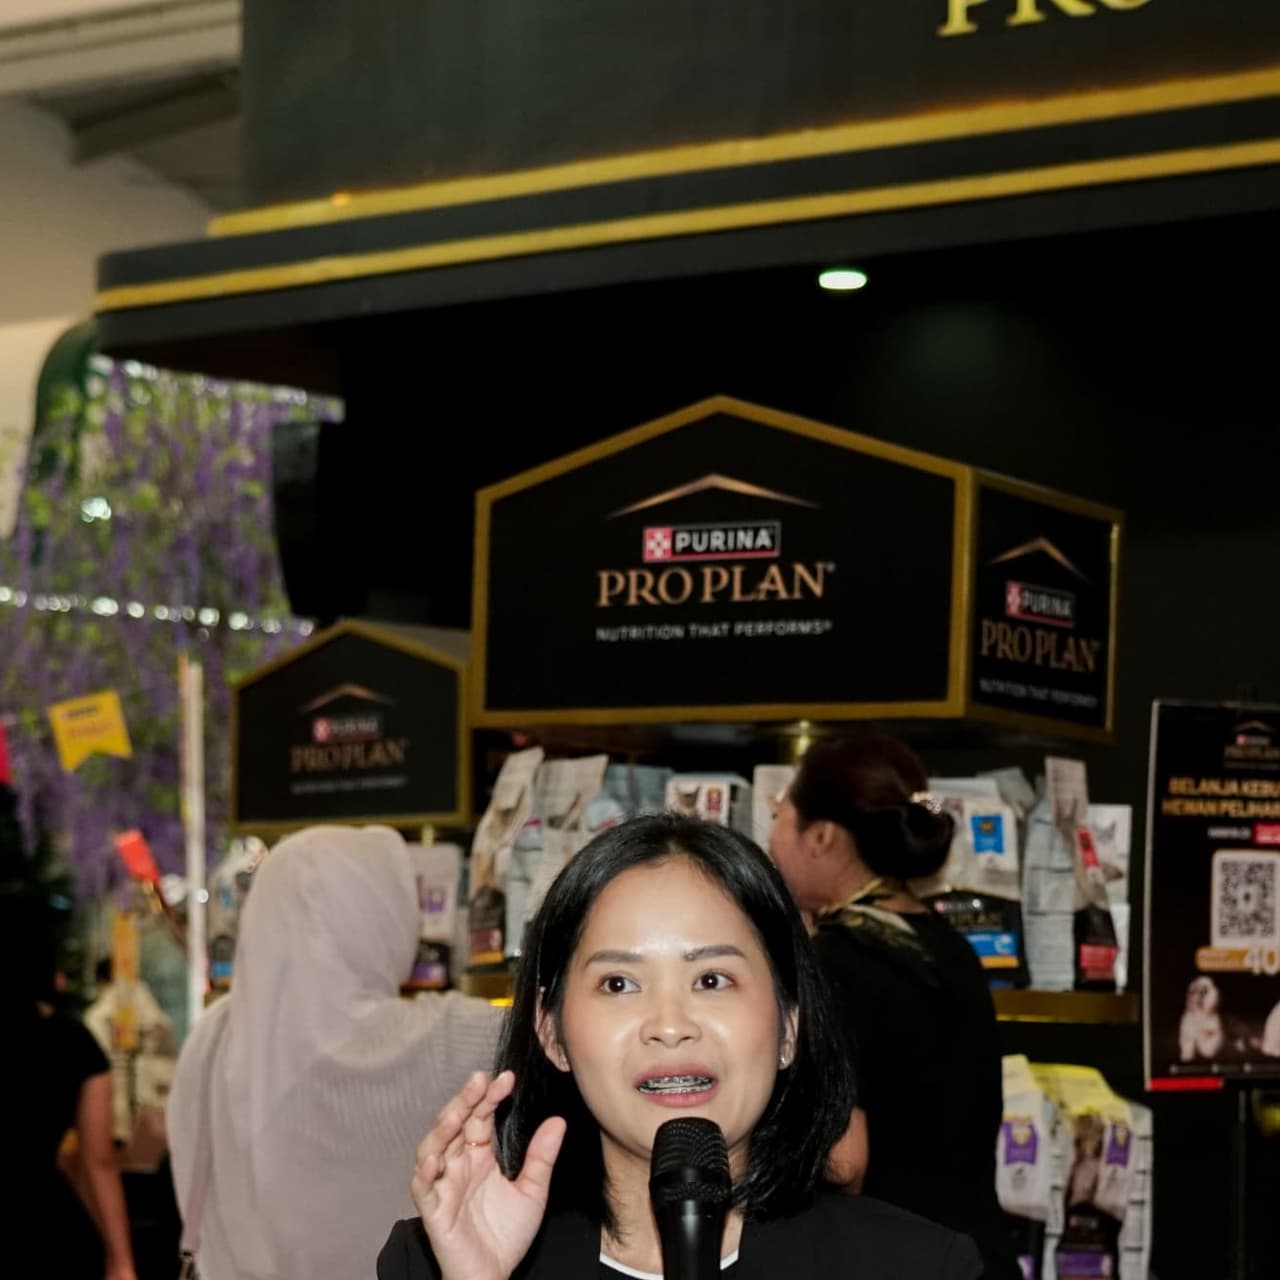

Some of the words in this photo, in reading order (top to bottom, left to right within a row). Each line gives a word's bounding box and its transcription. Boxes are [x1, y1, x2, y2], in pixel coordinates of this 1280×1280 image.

[675, 528, 772, 553] PURINA
[597, 567, 693, 606] PRO
[700, 562, 825, 603] PLAN
[1022, 590, 1073, 616] PURINA
[596, 622, 684, 642] NUTRITION
[689, 621, 729, 639] THAT
[981, 618, 1032, 663] PRO
[1035, 629, 1096, 672] PLAN
